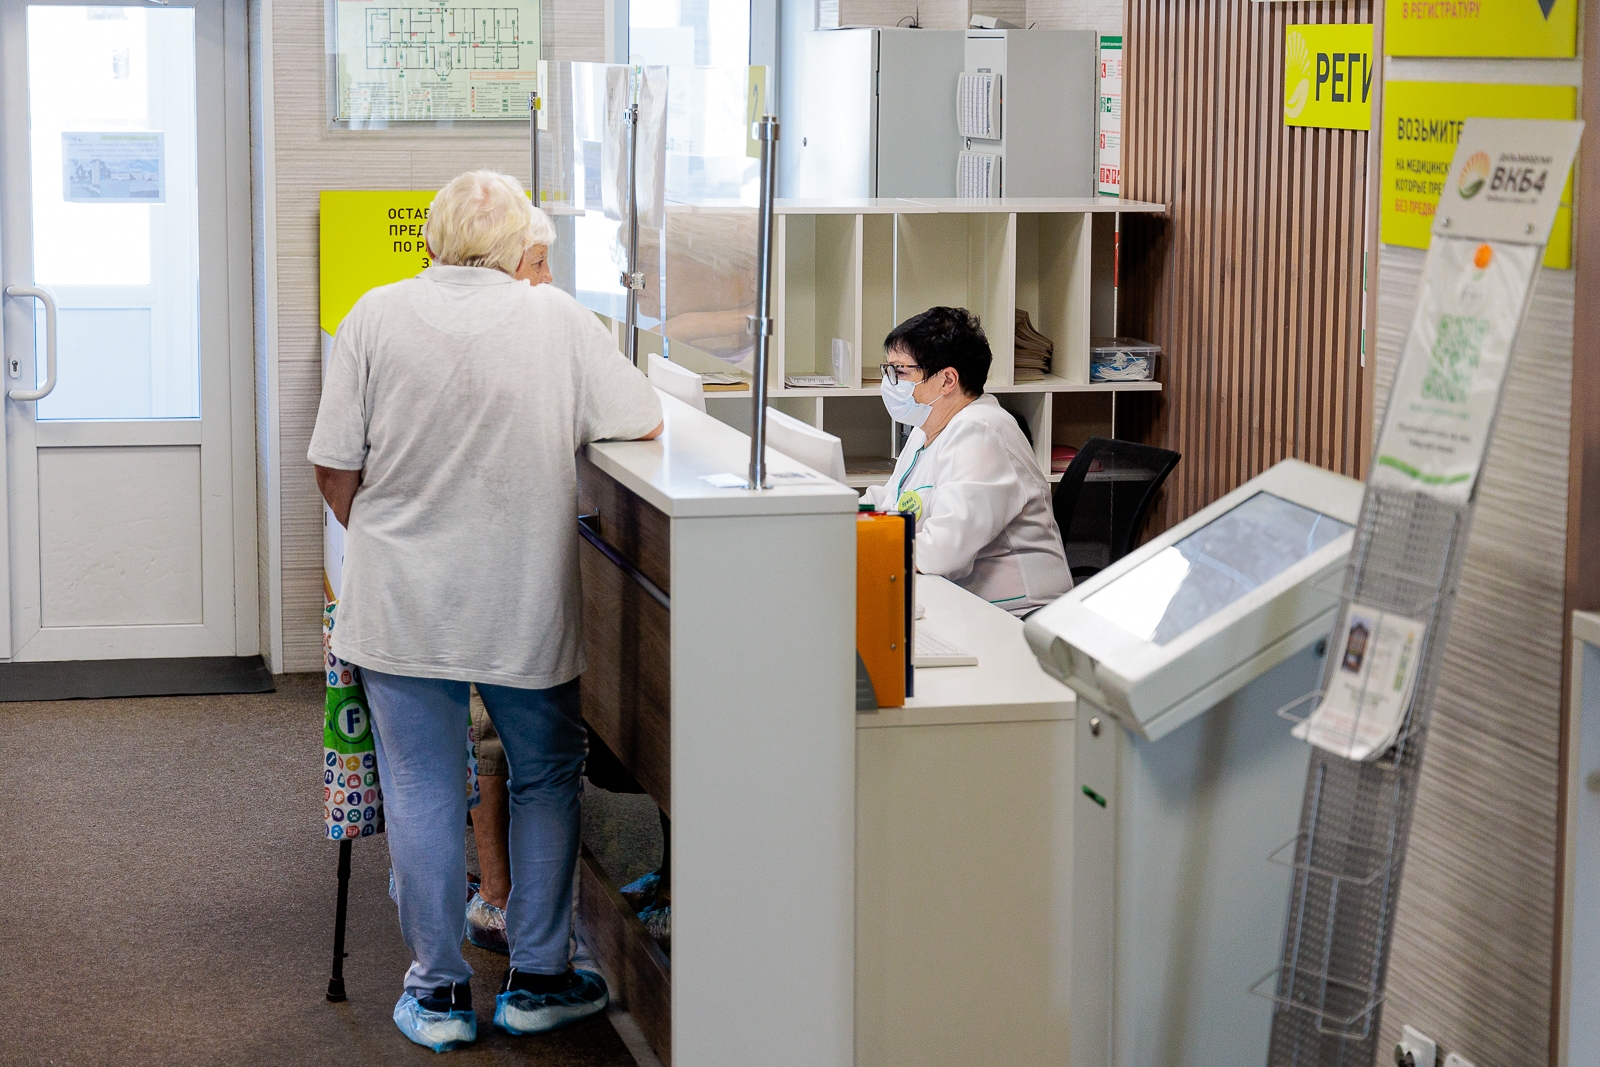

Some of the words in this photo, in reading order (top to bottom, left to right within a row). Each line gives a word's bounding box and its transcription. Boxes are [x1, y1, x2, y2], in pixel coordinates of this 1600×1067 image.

[1403, 1, 1408, 19] В
[1411, 1, 1480, 19] РЕГИСТРАТУРУ
[1396, 158, 1405, 171] НА
[1395, 178, 1427, 194] КОТОРЫЕ
[1490, 165, 1549, 195] ВКБ4
[1395, 198, 1408, 213] БЕЗ
[394, 241, 412, 252] ПО
[416, 241, 427, 252] Р
[346, 708, 360, 734] F
